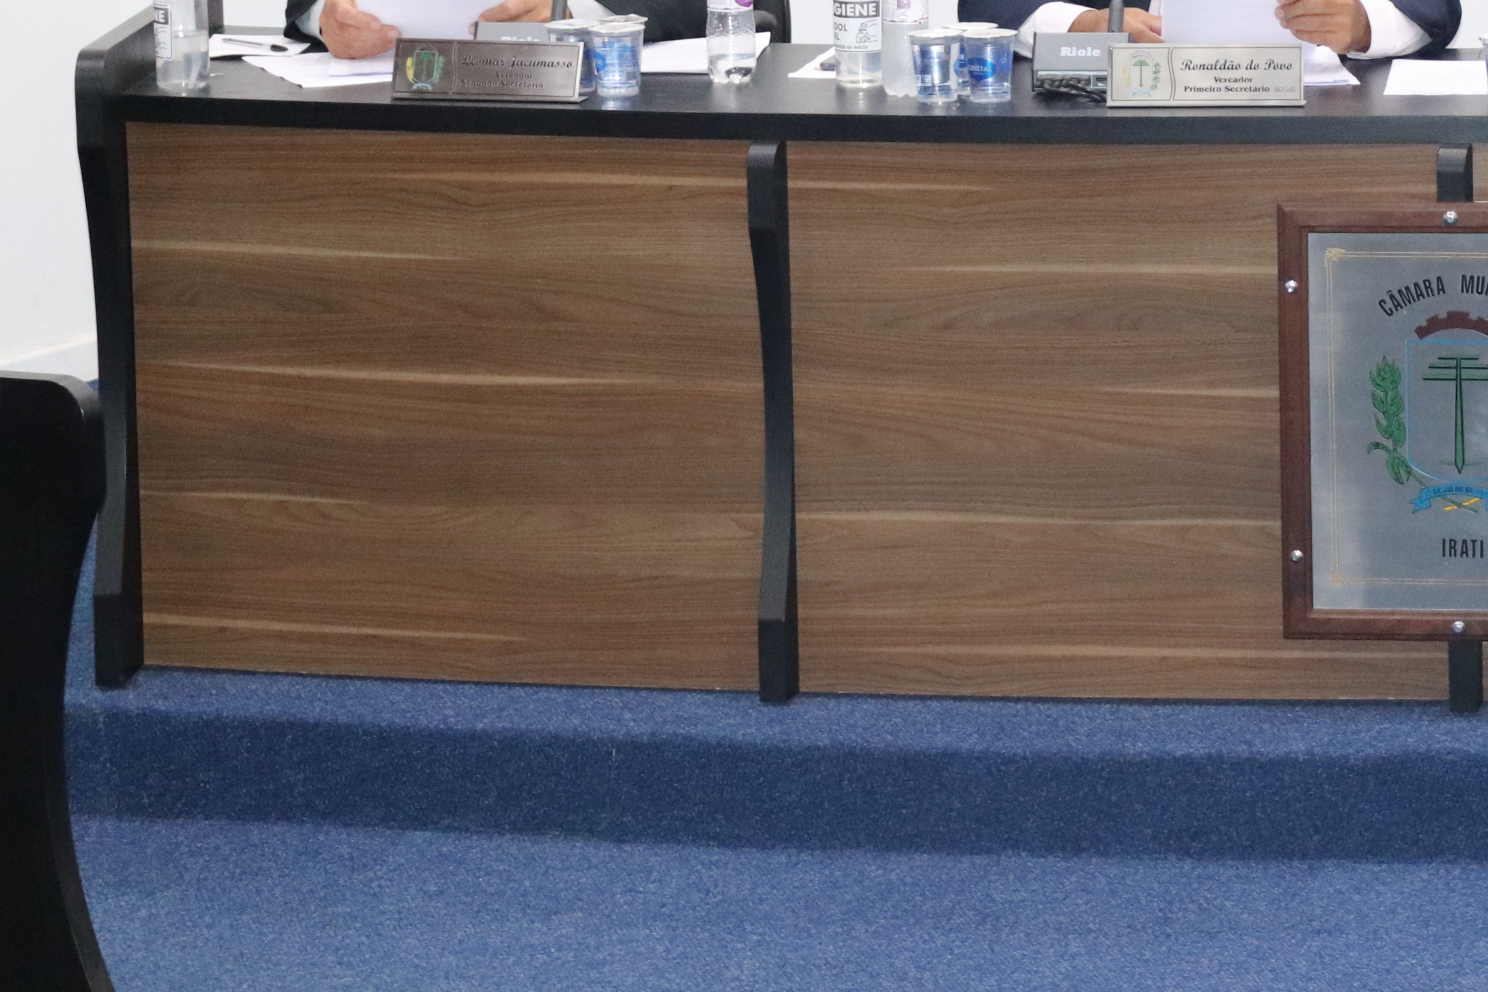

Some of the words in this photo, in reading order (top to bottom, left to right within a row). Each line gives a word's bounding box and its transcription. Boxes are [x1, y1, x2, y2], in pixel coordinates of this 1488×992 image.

[1060, 46, 1102, 57] Riole
[1180, 59, 1242, 71] Ronaldão
[1245, 59, 1261, 71] do
[1264, 58, 1293, 71] Povo
[1213, 76, 1253, 84] Vereador
[1184, 85, 1222, 93] Primeiro
[1378, 275, 1447, 317] CÂMARA
[1441, 538, 1484, 559] IRATI
